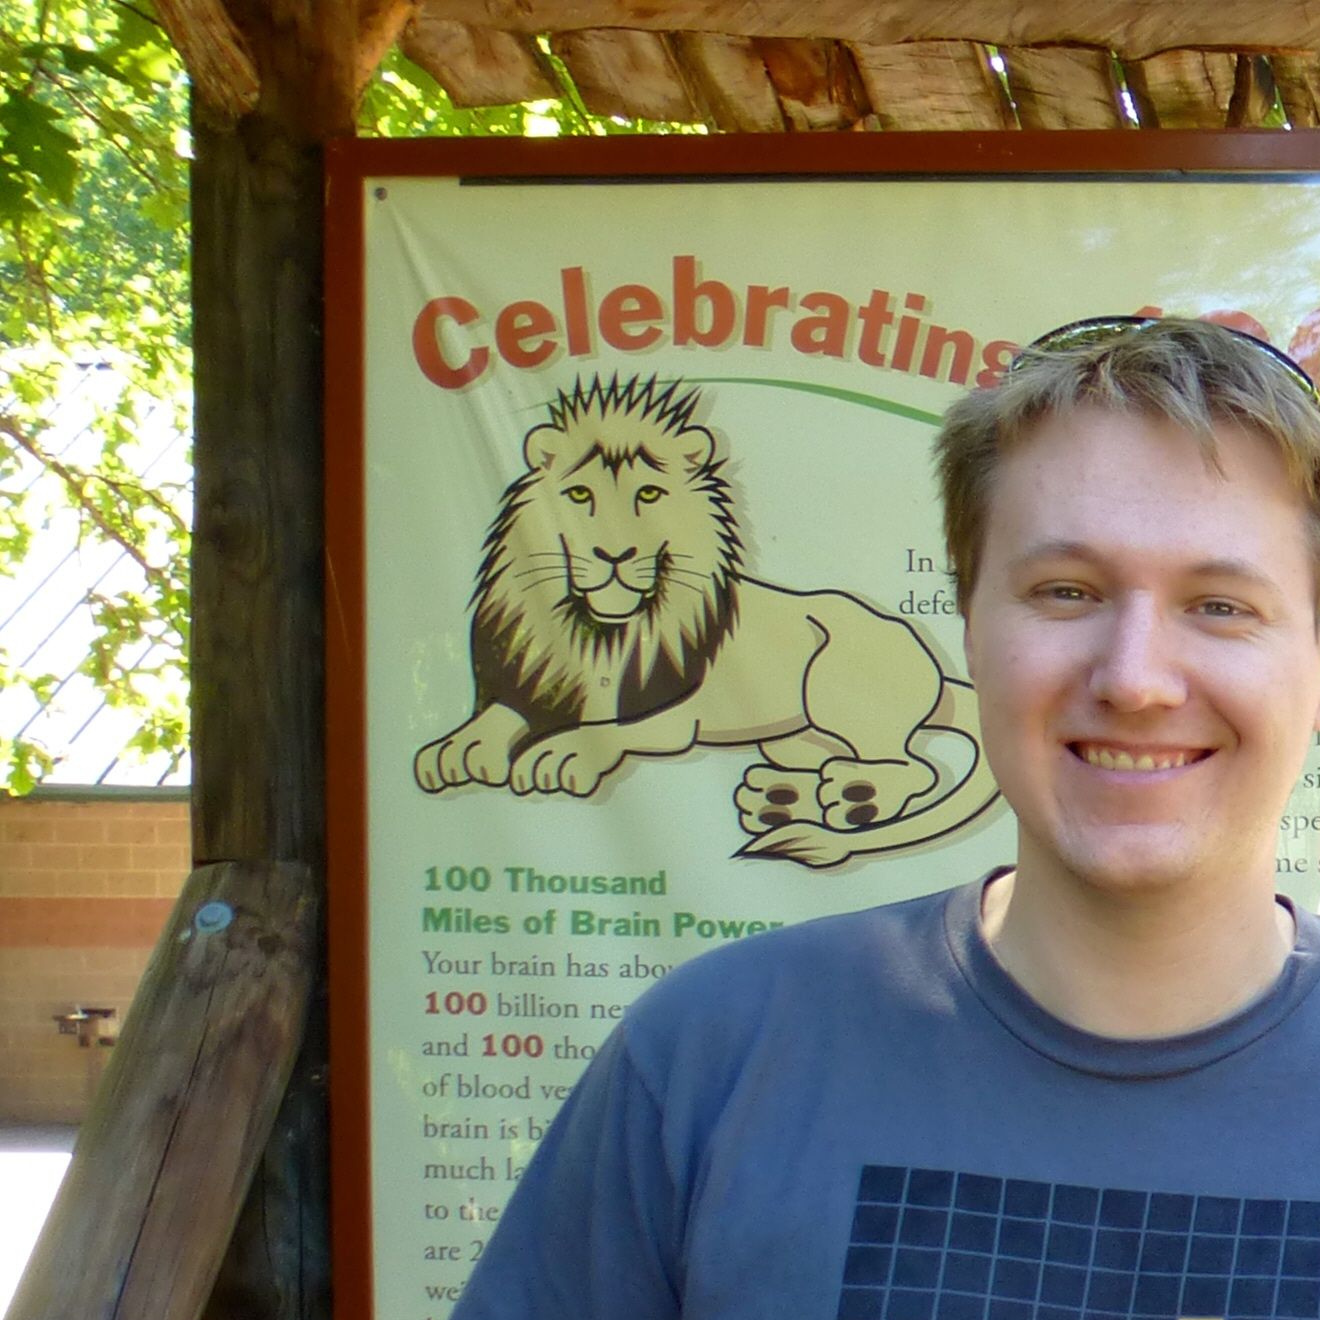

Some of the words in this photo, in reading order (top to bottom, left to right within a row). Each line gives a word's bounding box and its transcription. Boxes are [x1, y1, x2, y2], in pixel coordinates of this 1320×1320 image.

[906, 548, 935, 573] In
[899, 589, 956, 615] defe
[425, 866, 491, 893] 100
[504, 866, 667, 896] Thousand
[422, 906, 511, 935] Miles
[523, 908, 557, 936] of
[571, 909, 661, 938] Brain
[421, 950, 482, 975] Your
[490, 951, 556, 978] brain
[566, 953, 609, 978] has
[619, 954, 672, 980] abo
[425, 991, 488, 1016] 100
[497, 993, 579, 1019] billion
[591, 1003, 630, 1020] ne
[422, 1033, 469, 1057] and
[482, 1033, 544, 1058] 100
[554, 1035, 597, 1060] tho
[422, 1072, 452, 1098] of
[457, 1073, 531, 1100] blood
[422, 1114, 489, 1140] brain
[500, 1117, 519, 1141] is
[424, 1156, 495, 1181] much
[505, 1157, 525, 1182] la
[425, 1203, 449, 1221] to
[459, 1197, 499, 1222] the
[424, 1244, 461, 1261] are
[469, 1239, 485, 1262] 2
[425, 1281, 466, 1302] we
